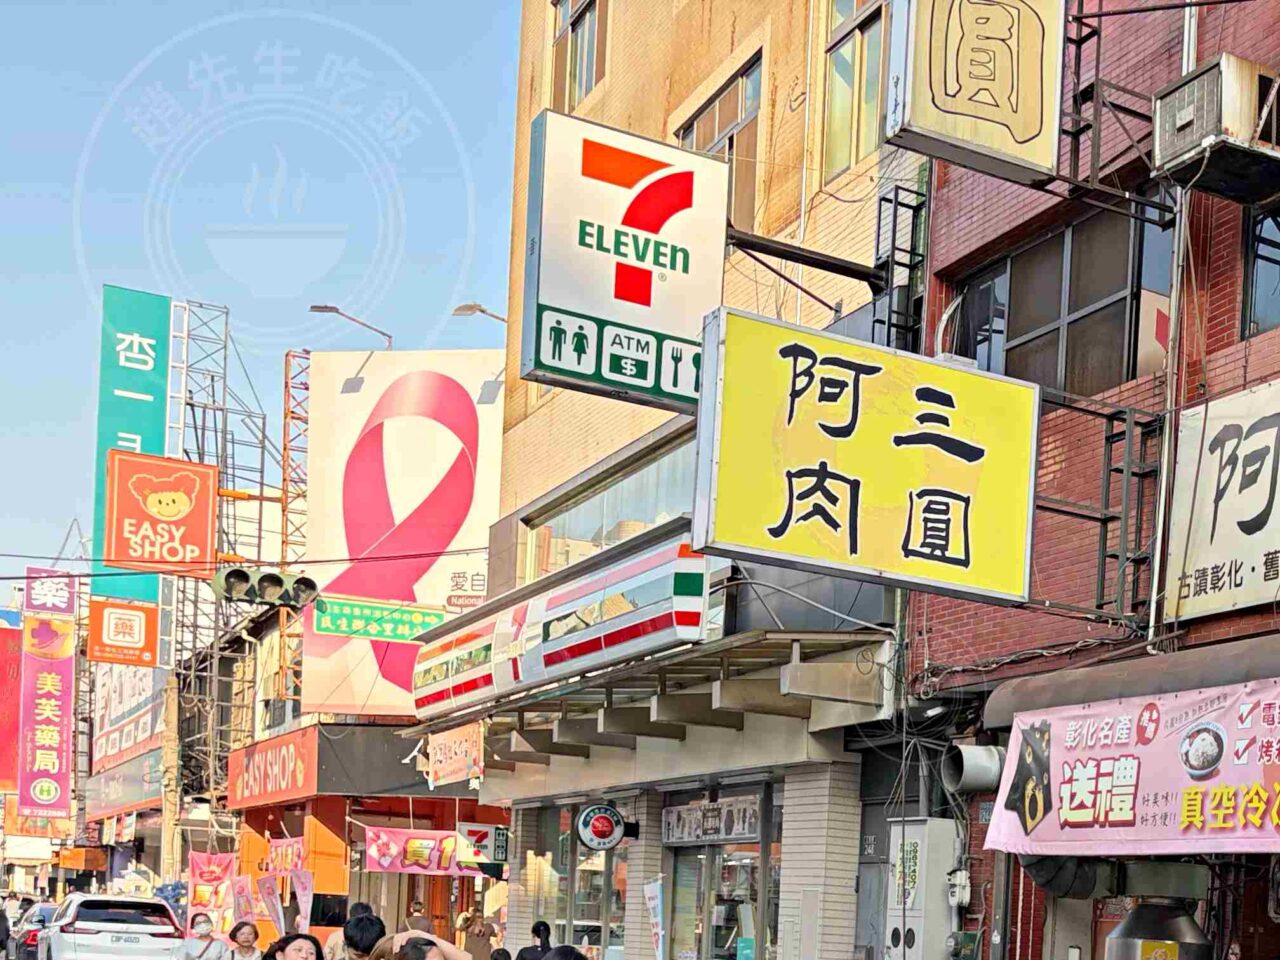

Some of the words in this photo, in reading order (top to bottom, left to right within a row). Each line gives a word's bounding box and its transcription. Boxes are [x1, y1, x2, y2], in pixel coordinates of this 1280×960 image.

[610, 330, 651, 356] ATM
[778, 342, 986, 464] 阿三
[123, 517, 187, 548] EASY
[768, 460, 972, 569] 肉圓
[128, 539, 201, 562] SHOP
[31, 570, 69, 609] 藥
[113, 616, 136, 640] 藥
[33, 672, 63, 775] 美芙藥局
[1064, 715, 1132, 749] 彰化名產
[242, 756, 264, 798] EASY
[266, 743, 295, 793] SHOP
[1058, 754, 1140, 829] 送禮
